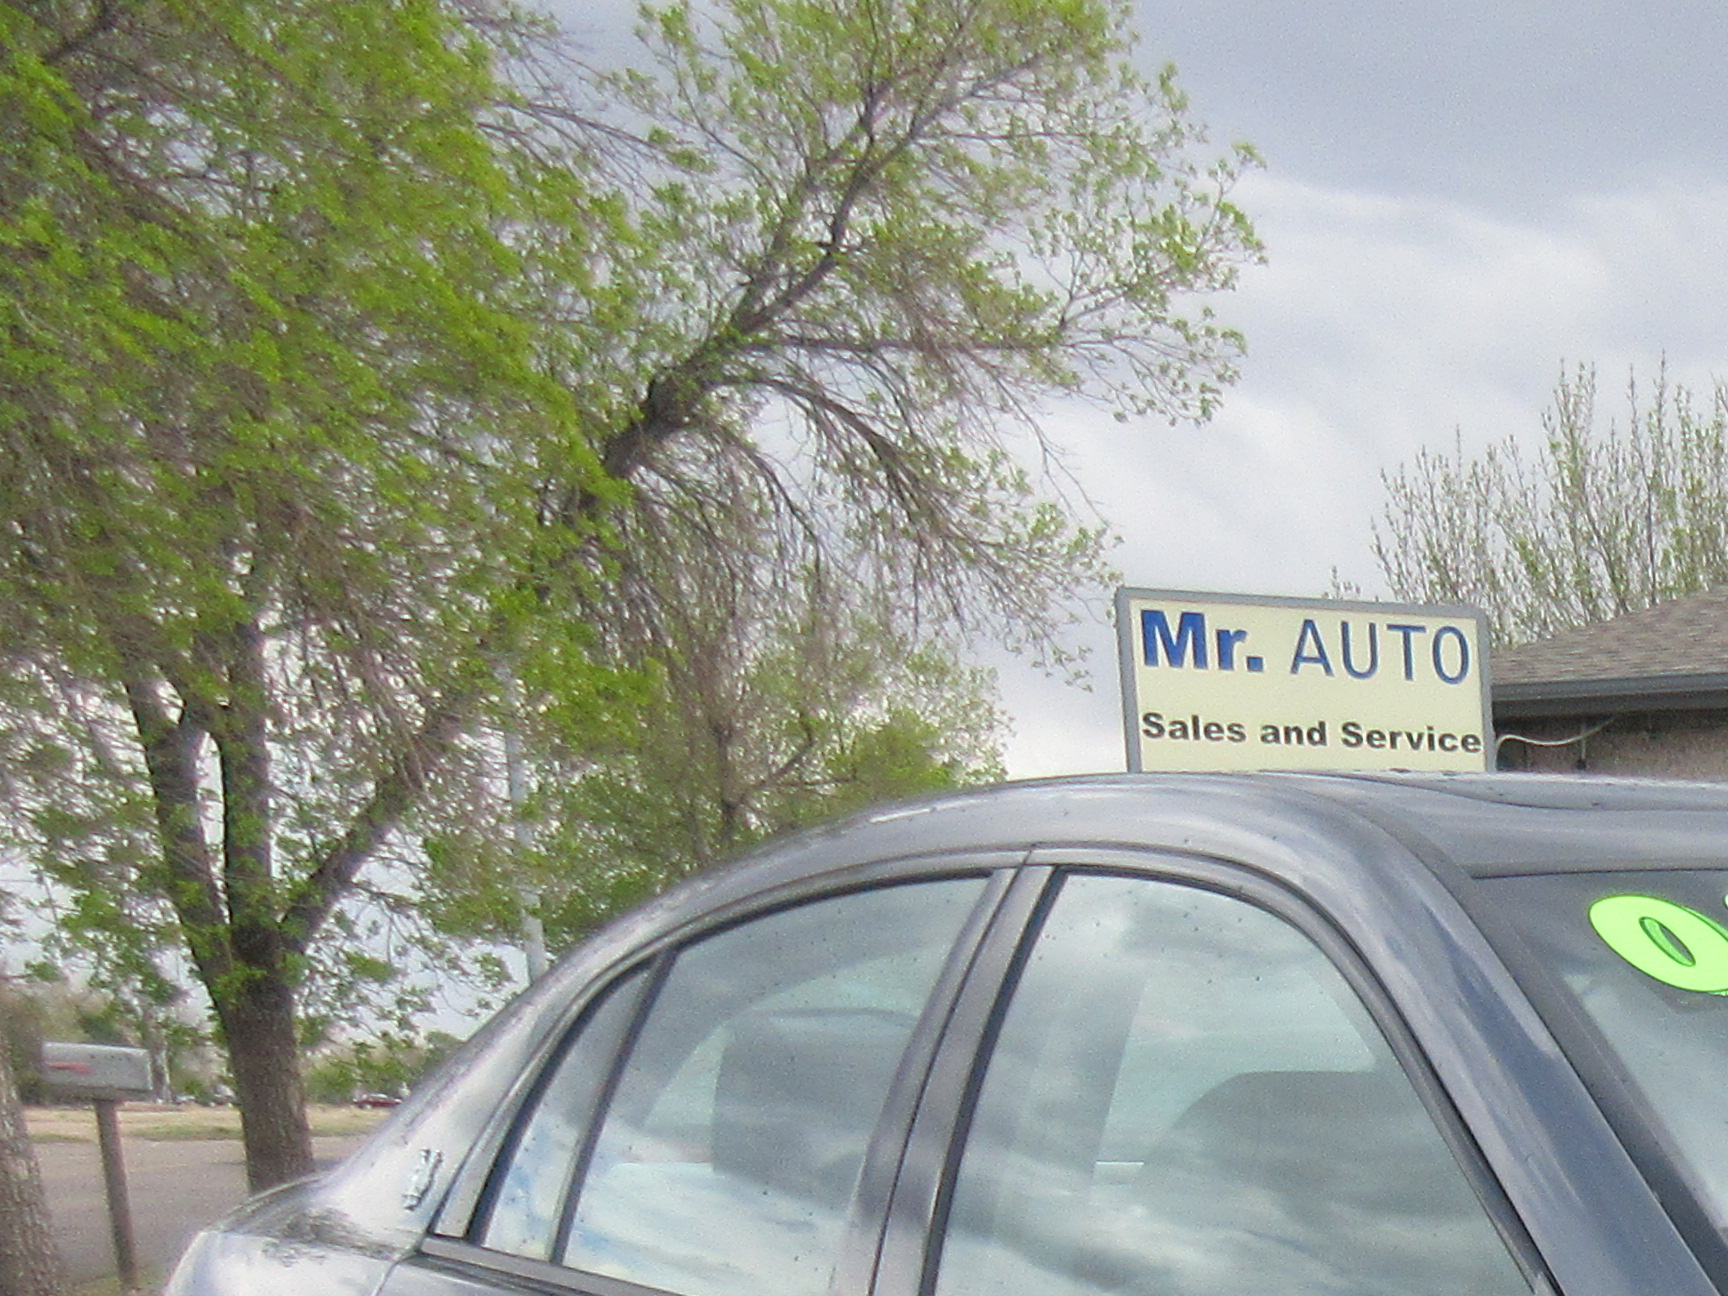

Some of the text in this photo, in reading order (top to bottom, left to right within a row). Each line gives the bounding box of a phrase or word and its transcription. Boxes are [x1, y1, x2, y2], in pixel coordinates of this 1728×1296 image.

[1140, 608, 1471, 686] Mr. AUTO
[1141, 711, 1482, 754] Sales and Service
